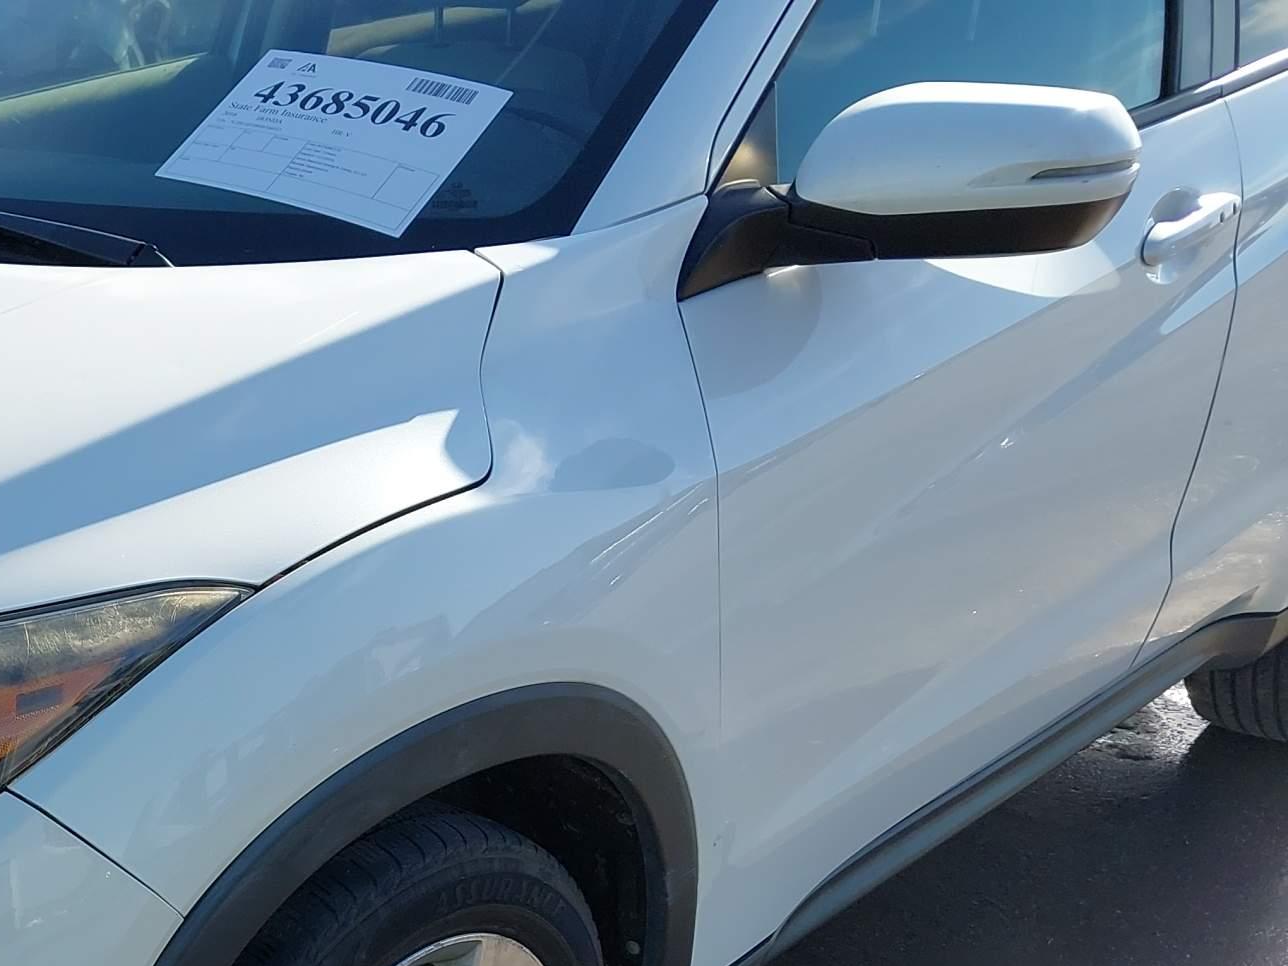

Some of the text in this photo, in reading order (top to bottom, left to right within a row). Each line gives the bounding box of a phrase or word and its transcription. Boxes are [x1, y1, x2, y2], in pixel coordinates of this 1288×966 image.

[229, 101, 253, 111] State
[253, 104, 279, 115] Farm
[280, 108, 328, 124] Insurance
[254, 80, 456, 138] 43685046
